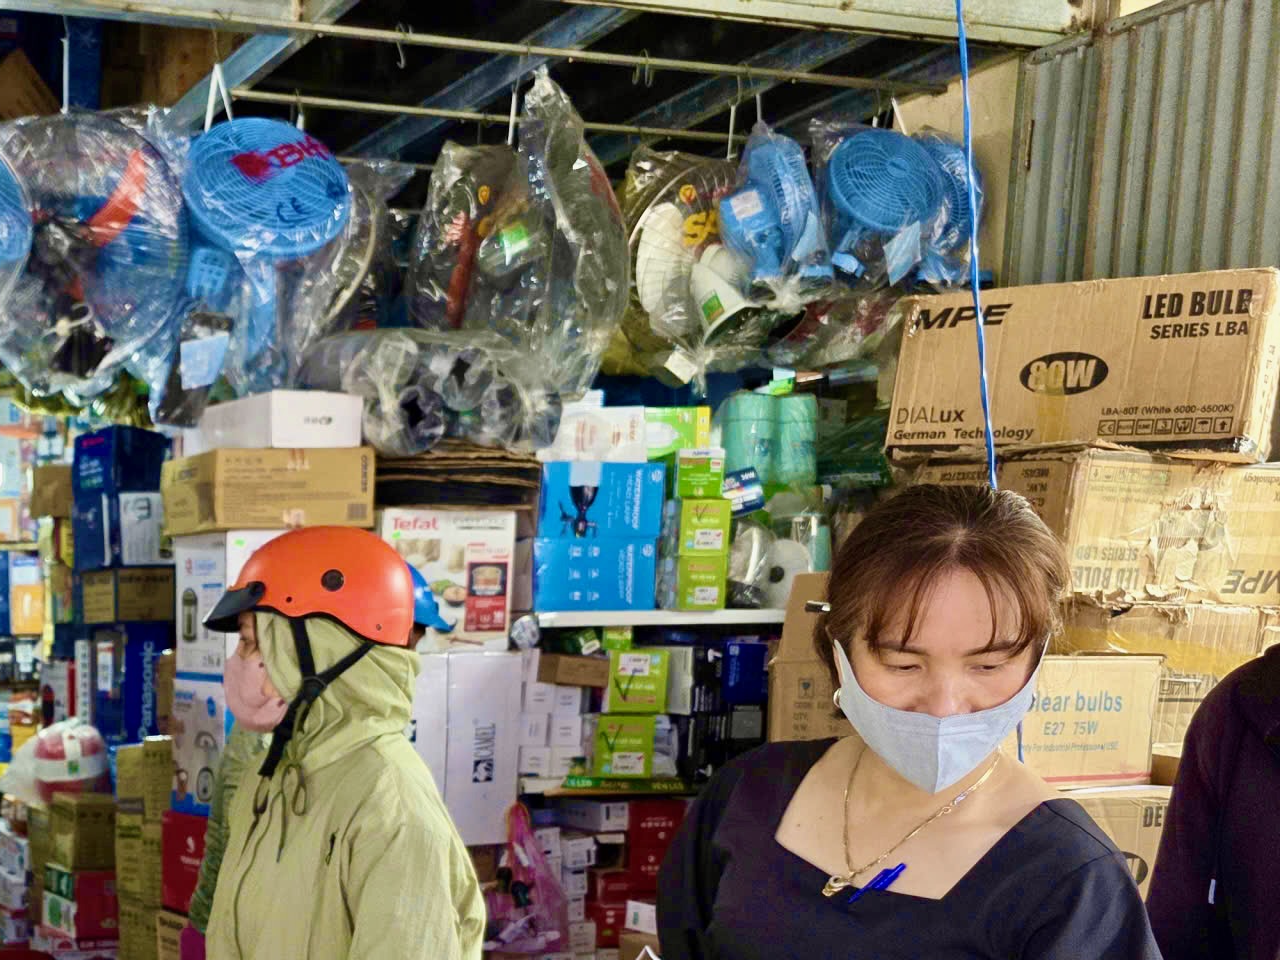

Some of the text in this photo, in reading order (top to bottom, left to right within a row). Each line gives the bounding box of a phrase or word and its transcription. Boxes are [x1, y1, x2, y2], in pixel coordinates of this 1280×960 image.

[1142, 289, 1253, 319] LED BULB
[916, 304, 1013, 330] MPE
[1150, 321, 1249, 340] SERIES LBA
[1027, 360, 1097, 390] 80W
[896, 406, 965, 425] DIALux
[893, 426, 1034, 441] German Techology
[392, 517, 439, 530] Tefal
[1101, 546, 1139, 561] SERIES
[138, 641, 153, 740] Panasonic
[1075, 691, 1123, 712] bulbs
[1043, 721, 1099, 736] E27 75W
[1142, 806, 1167, 828] DE
